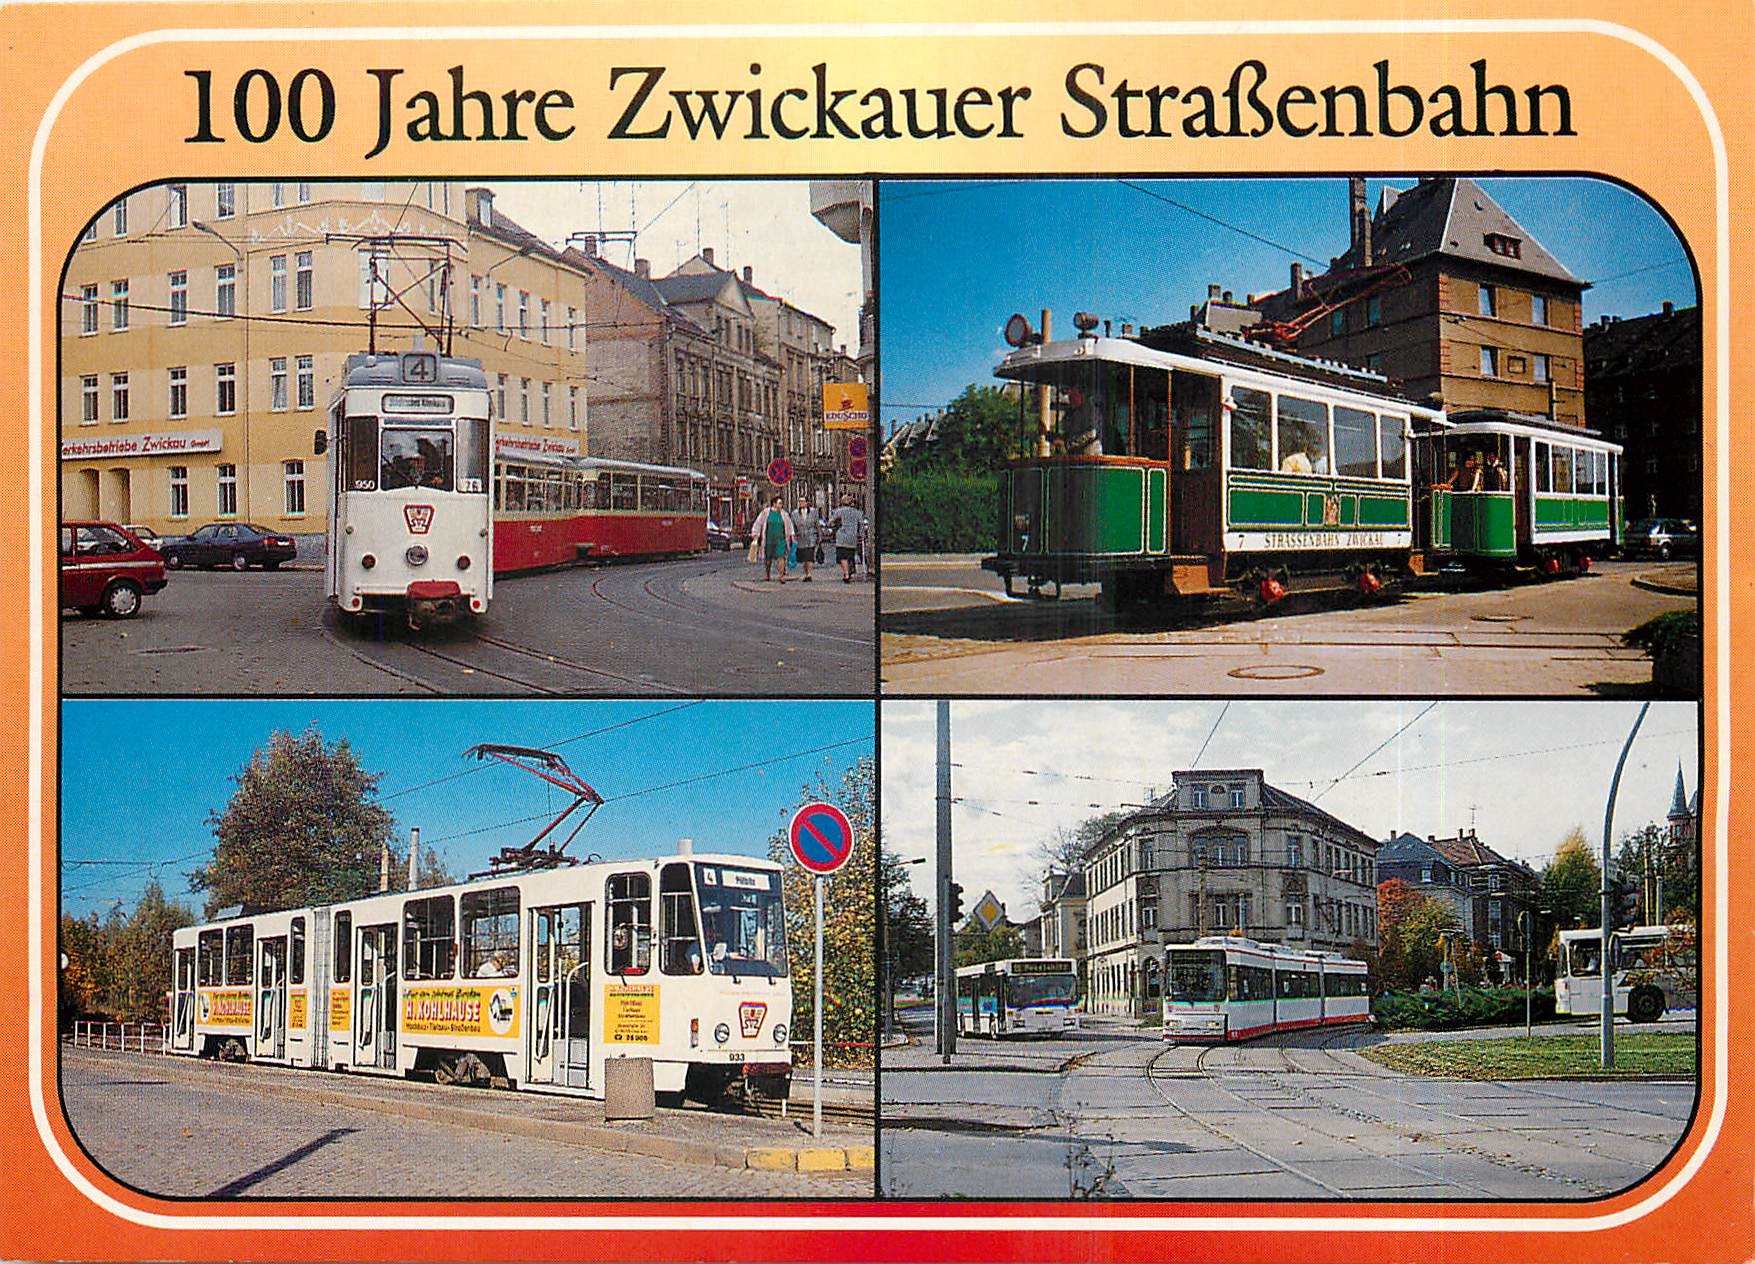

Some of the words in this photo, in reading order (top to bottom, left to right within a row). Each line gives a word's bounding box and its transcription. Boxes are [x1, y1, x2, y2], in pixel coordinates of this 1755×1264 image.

[184, 69, 336, 144] 100
[365, 65, 576, 160] Jahre
[607, 62, 1032, 141] Zwickauer
[1060, 58, 1578, 139] Straßenbahn
[409, 357, 429, 380] 4
[825, 411, 868, 421] EDUSCHO
[61, 439, 138, 456] erkehrsbetriebe
[142, 436, 187, 452] Zwickau
[354, 480, 376, 490] 950
[1020, 534, 1030, 553] 7
[1237, 533, 1246, 549] 7
[1263, 532, 1341, 549] STRASSENBAHN
[1346, 532, 1384, 547] ZWICKAU
[706, 871, 715, 882] 4
[418, 1000, 481, 1022] KOHLHAUSE
[728, 1053, 746, 1062] 933
